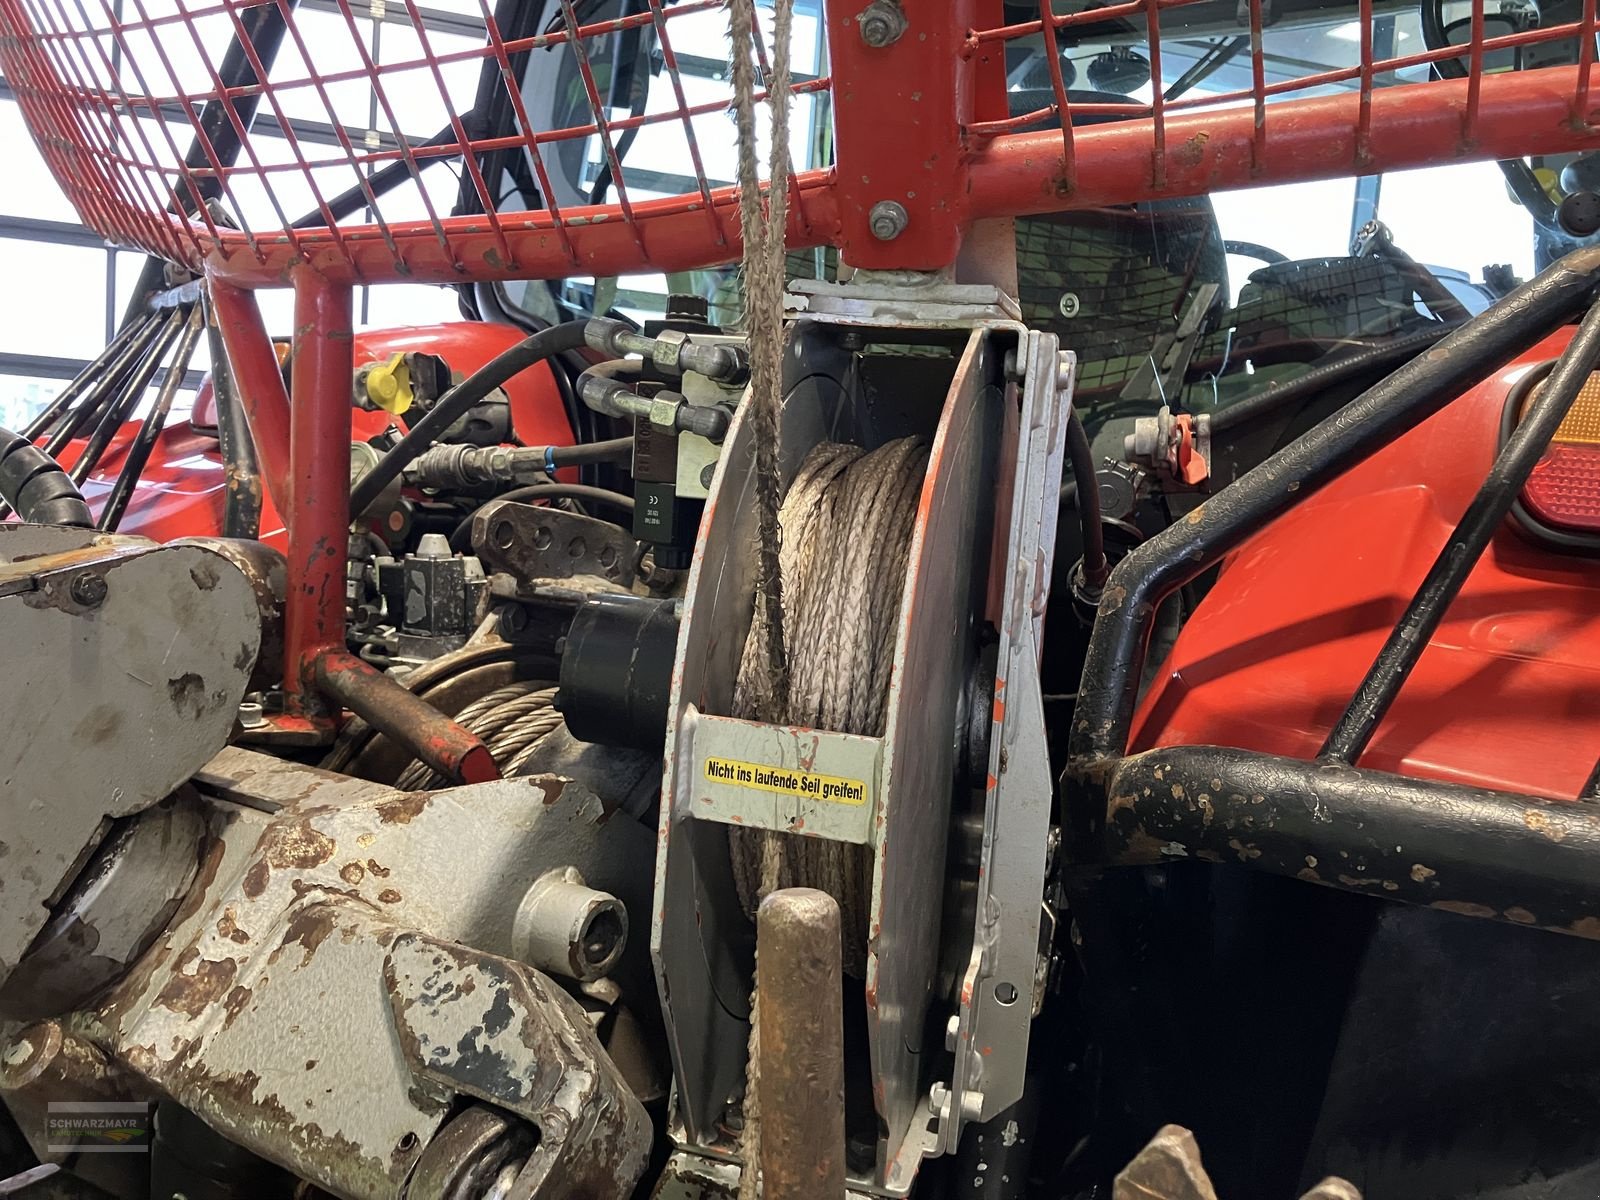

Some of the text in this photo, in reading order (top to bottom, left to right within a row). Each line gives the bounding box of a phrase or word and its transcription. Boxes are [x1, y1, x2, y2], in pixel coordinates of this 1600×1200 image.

[708, 760, 864, 801] Nicht ins laufende Seil greifen!
